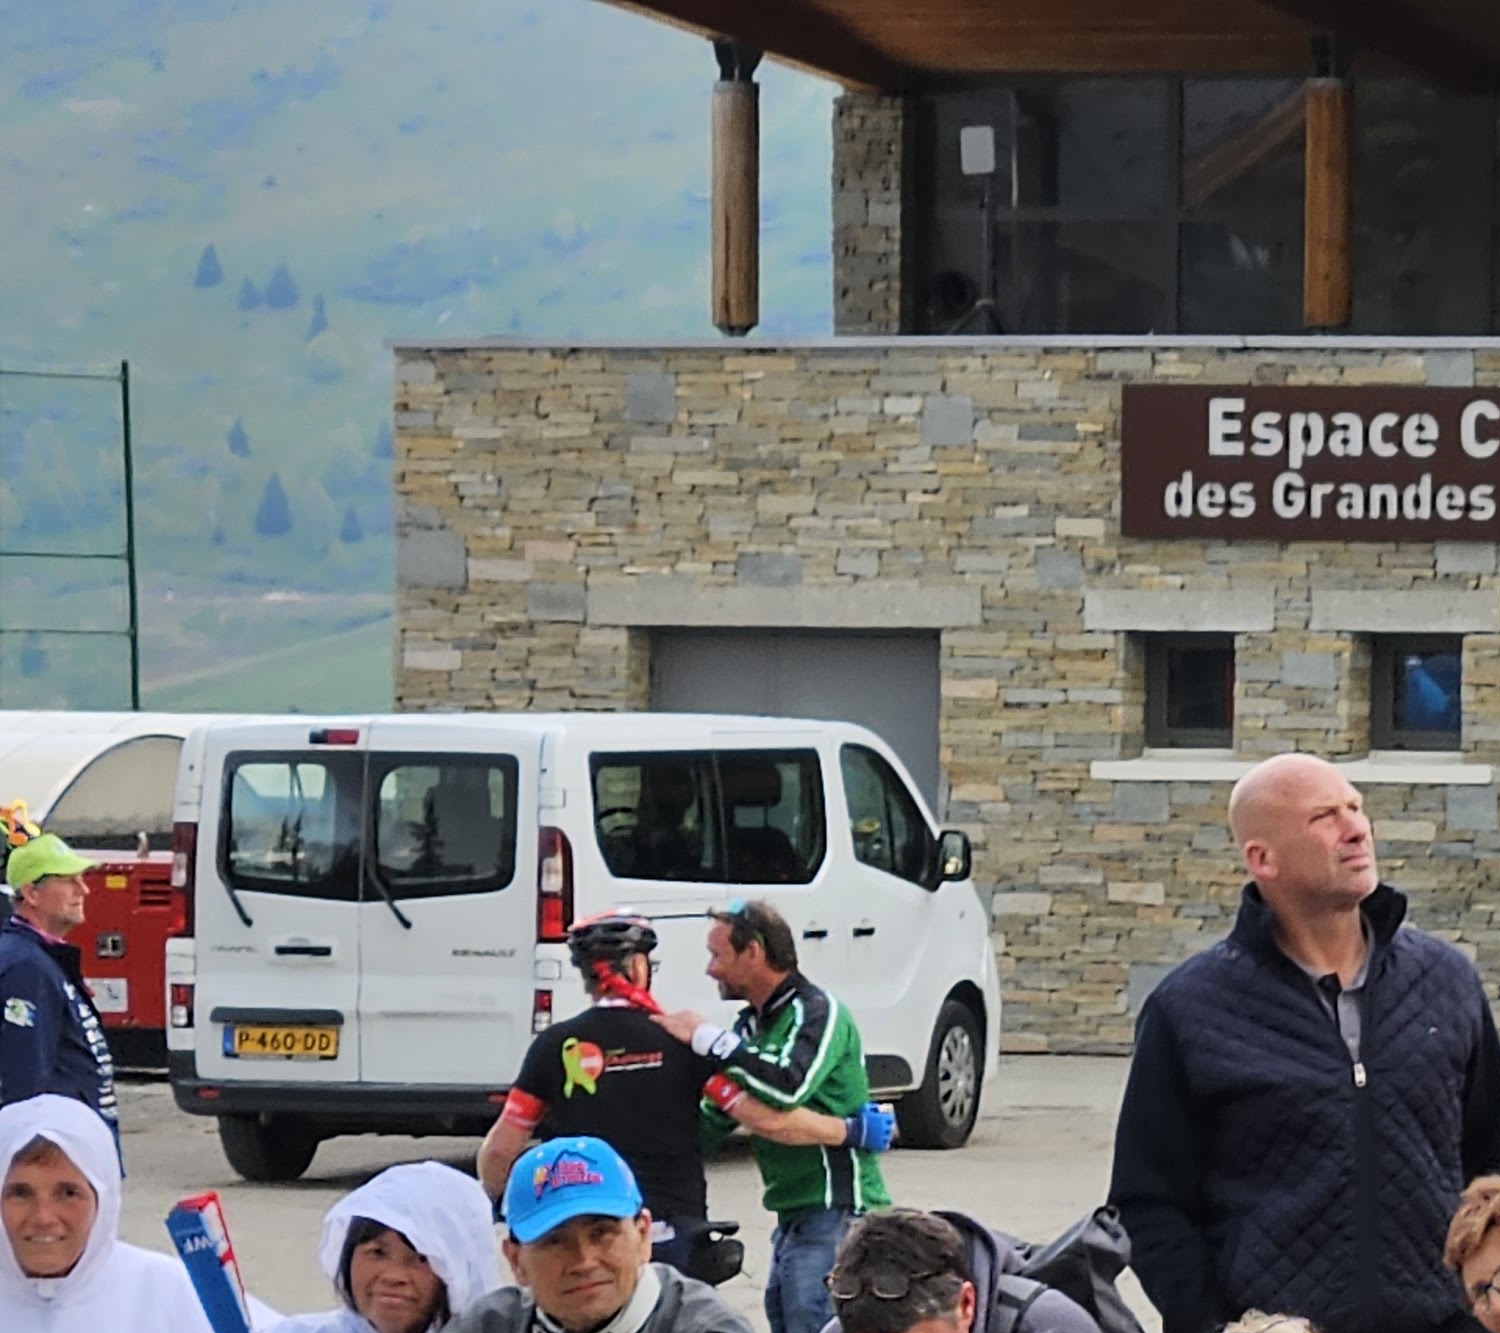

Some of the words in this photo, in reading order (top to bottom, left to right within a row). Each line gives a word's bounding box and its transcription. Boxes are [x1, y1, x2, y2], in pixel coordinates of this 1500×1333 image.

[1207, 397, 1440, 470] Espace
[1163, 472, 1256, 520] des
[1272, 473, 1497, 522] Grandes
[237, 1030, 332, 1054] P-460-DD
